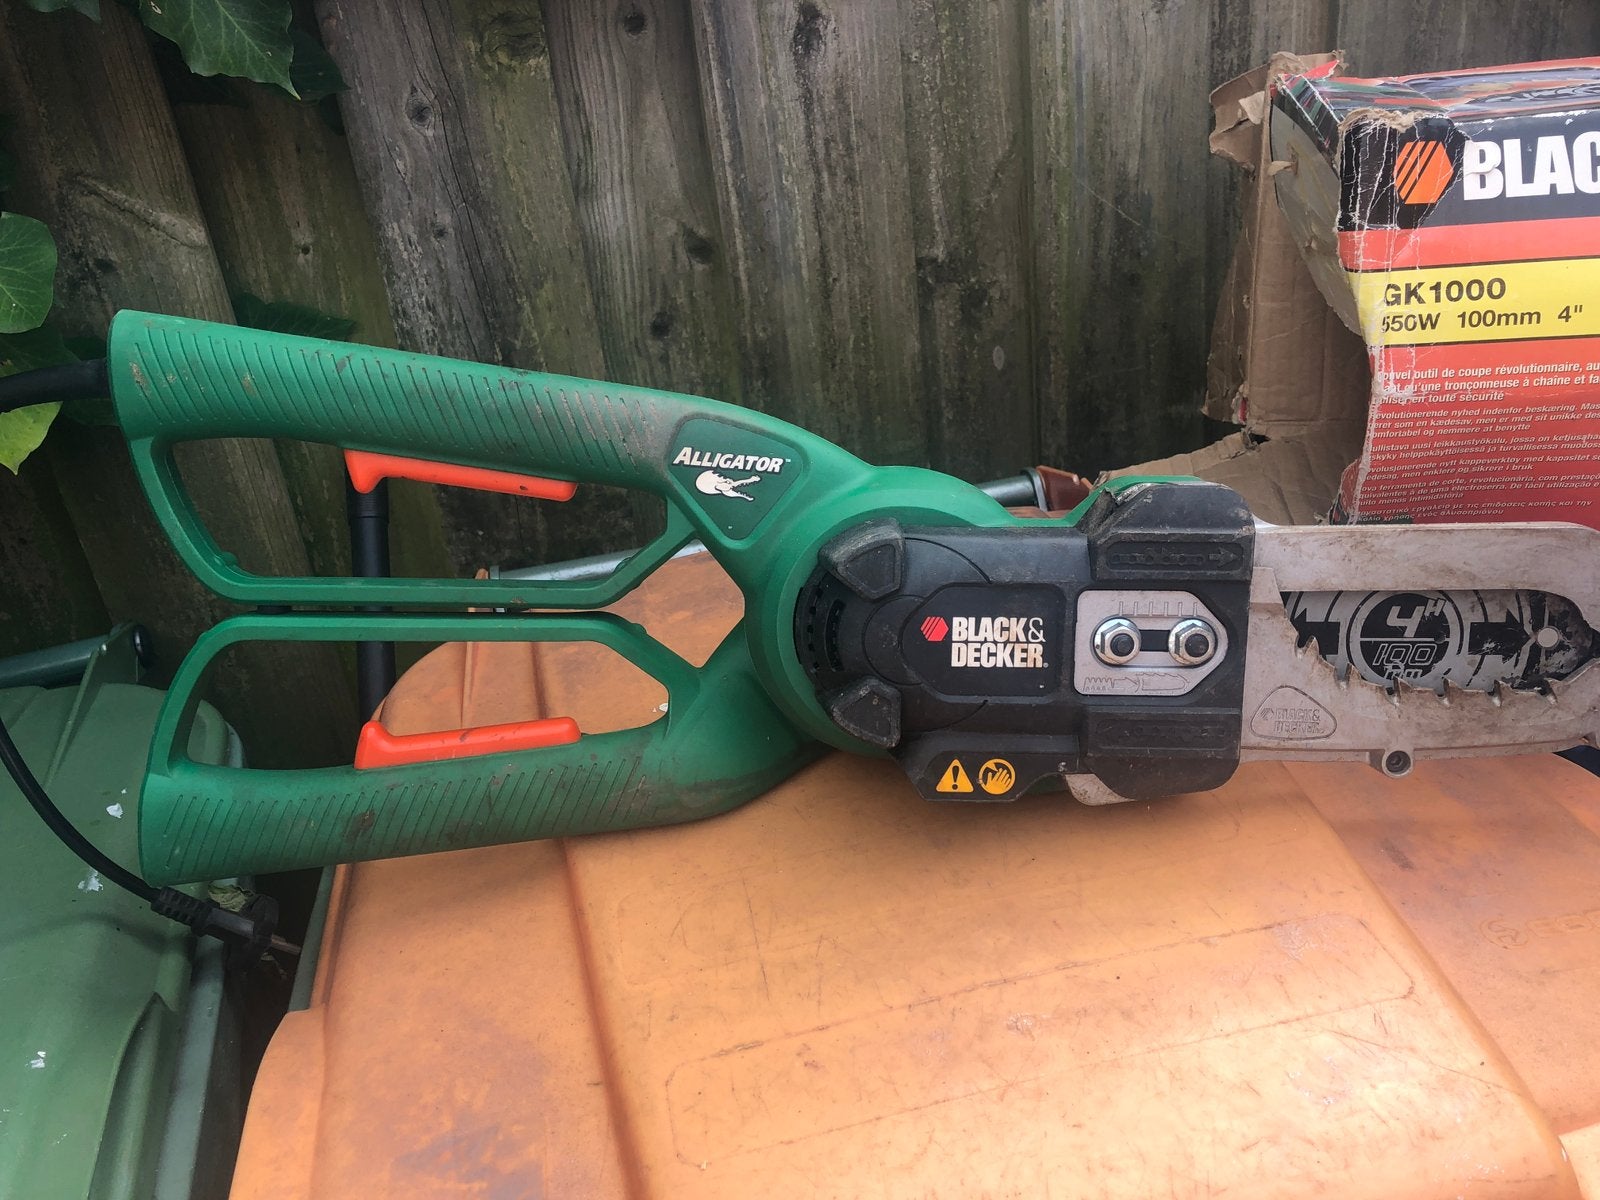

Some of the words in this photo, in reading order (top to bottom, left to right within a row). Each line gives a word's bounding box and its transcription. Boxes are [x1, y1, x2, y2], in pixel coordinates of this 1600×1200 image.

[1384, 277, 1506, 306] GK1000
[1457, 309, 1541, 328] 100mm
[1557, 304, 1583, 323] 4"
[1378, 370, 1411, 380] ouvel
[1414, 368, 1438, 379] outil
[1442, 367, 1455, 377] de
[1458, 366, 1491, 378] coupe
[1495, 362, 1582, 375] révolutionnaire,
[1445, 379, 1520, 391] tronçonneuse
[1523, 376, 1530, 387] à
[1533, 374, 1571, 387] chaîne
[1574, 375, 1586, 385] et
[1429, 394, 1456, 403] toute
[1459, 391, 1504, 402] sécurité
[1375, 409, 1449, 420] evolutionerende
[1451, 408, 1479, 418] nyhed
[1483, 406, 1522, 416] indenfor
[1525, 404, 1577, 414] beskæring.
[1394, 421, 1414, 430] som
[1416, 420, 1428, 428] en
[1476, 418, 1496, 426] men
[1511, 415, 1533, 424] med
[1535, 413, 1547, 422] sit
[1550, 412, 1583, 422] unikke
[1373, 429, 1421, 439] omfortabel
[1423, 429, 1435, 438] og
[1437, 426, 1481, 436] nemmere
[1483, 424, 1492, 432] at
[1494, 423, 1531, 432] benytte
[1371, 443, 1410, 453] ullistava
[1412, 441, 1431, 450] uusi
[1510, 436, 1535, 445] jossa
[1538, 435, 1550, 443] on
[672, 447, 785, 473] ALLIGATOR
[1370, 451, 1397, 462] skyky
[1487, 446, 1497, 454] ja
[1439, 459, 1457, 468] nytt
[1523, 455, 1545, 464] med
[1546, 454, 1590, 464] kapasitet
[1366, 473, 1399, 482] edesag,
[1401, 471, 1421, 479] men
[1423, 468, 1456, 477] enklere
[1457, 467, 1469, 475] og
[1471, 465, 1504, 474] sikrere
[1511, 463, 1534, 472] bruk
[1361, 484, 1377, 492] ova
[1379, 481, 1427, 491] ferramenta
[1429, 479, 1440, 487] de
[1538, 474, 1559, 482] com
[1359, 489, 1407, 500] quivalentes
[1417, 487, 1429, 495] de
[1430, 486, 1450, 495] uma
[1372, 643, 1438, 666] 100
